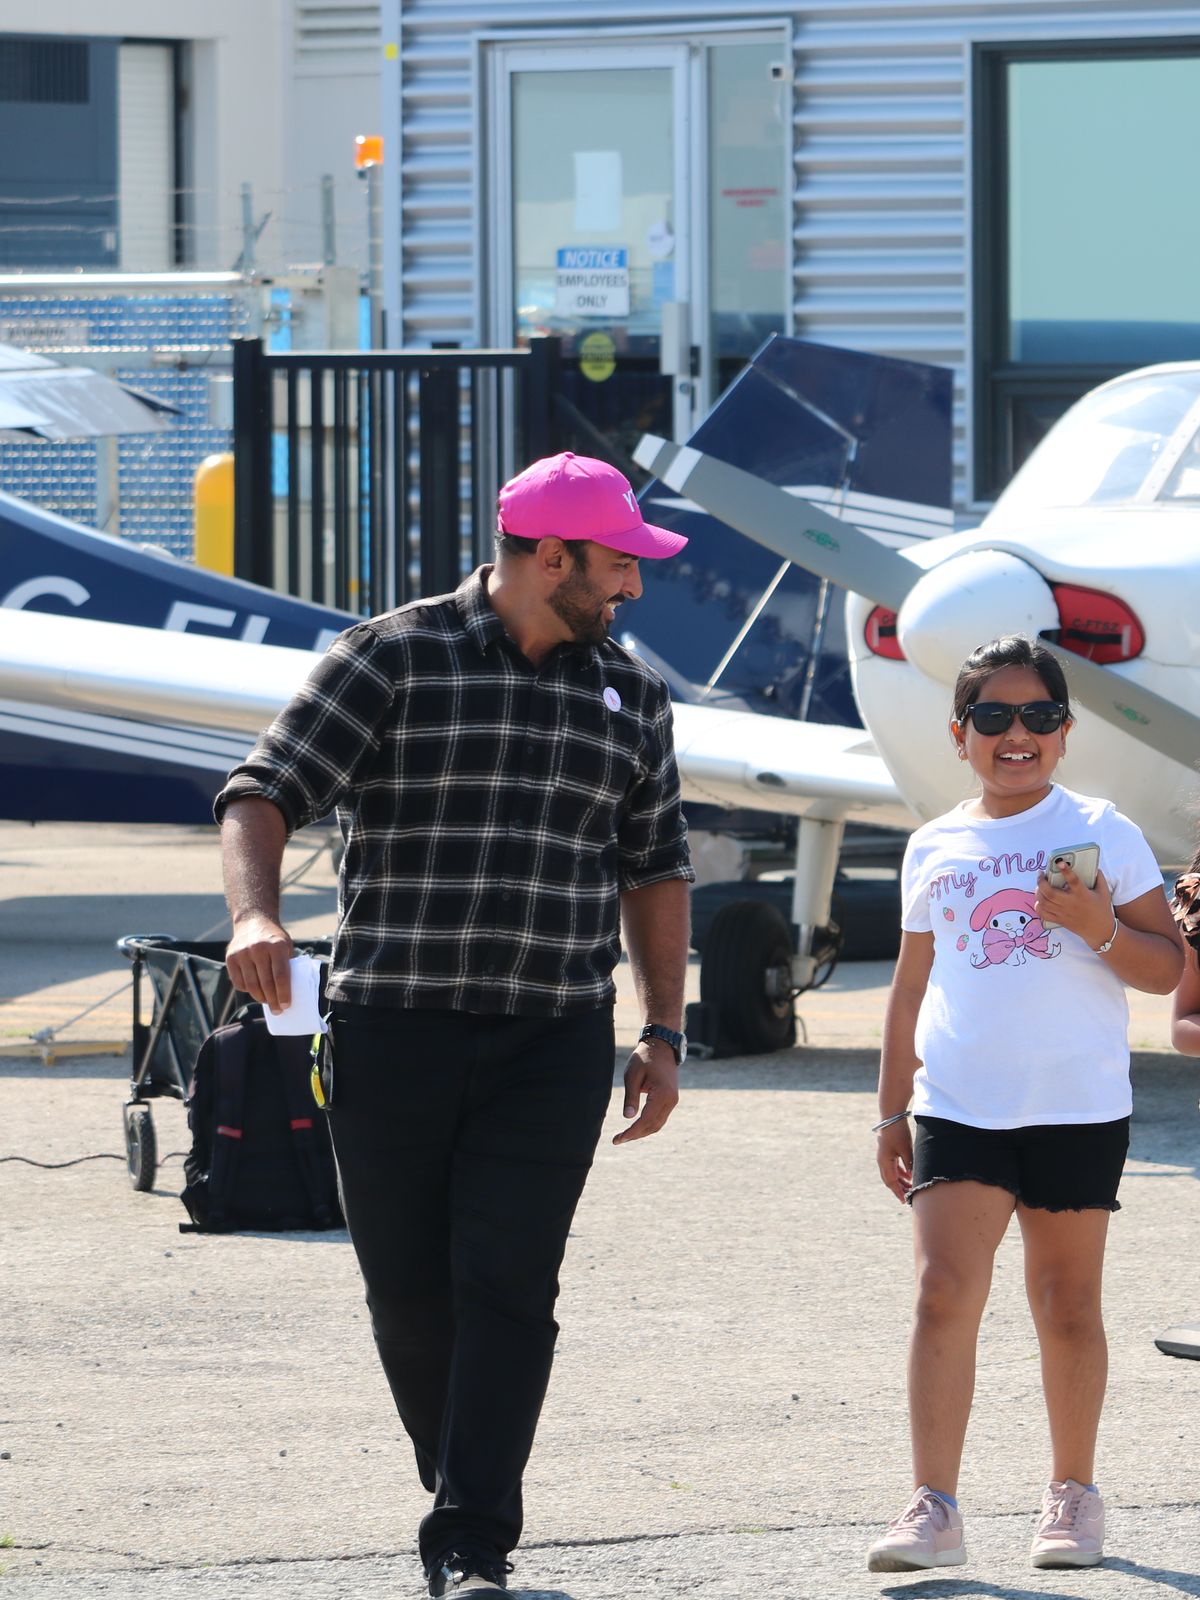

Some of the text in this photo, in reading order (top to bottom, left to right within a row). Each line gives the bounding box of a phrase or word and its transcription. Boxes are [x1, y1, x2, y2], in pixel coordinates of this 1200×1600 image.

[565, 250, 620, 268] NOTICE
[558, 274, 628, 288] EMPLOYEES
[577, 294, 608, 308] ONLY
[930, 850, 1047, 899] My Mel
